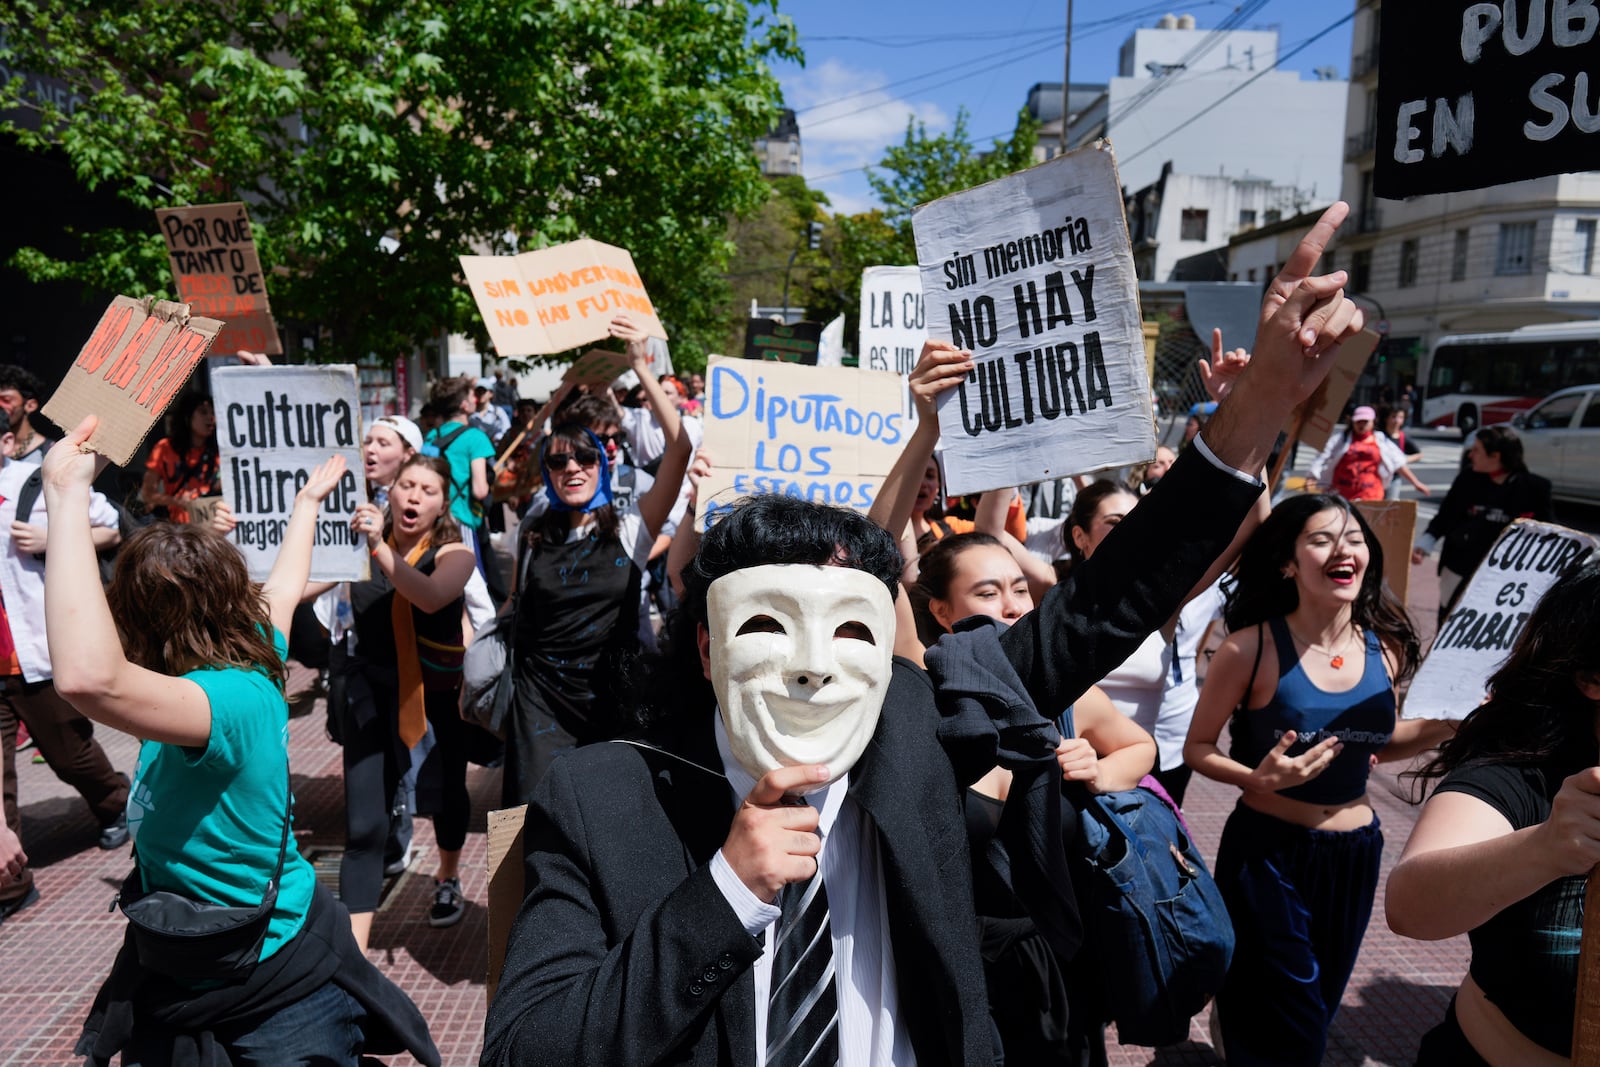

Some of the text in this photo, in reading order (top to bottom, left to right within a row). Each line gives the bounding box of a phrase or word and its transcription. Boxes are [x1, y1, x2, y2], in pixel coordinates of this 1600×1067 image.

[1394, 91, 1475, 164] EN
[163, 208, 252, 247] POR QUÉ
[170, 248, 245, 274] TANTO
[943, 216, 1092, 290] sin memoria
[180, 273, 262, 296] MIEDO DE
[484, 279, 521, 298] SIN
[183, 295, 257, 319] EDUCAR
[494, 308, 530, 328] NO
[536, 303, 570, 328] HAY
[870, 291, 893, 329] LA
[948, 264, 1097, 350] NO HAY
[870, 346, 888, 371] es
[958, 330, 1113, 437] CULTURA
[227, 391, 354, 448] cultura
[755, 441, 831, 476] LOS
[734, 474, 874, 508] ESTAMOS
[235, 515, 359, 551] negacismo
[1495, 582, 1528, 607] es
[1433, 607, 1531, 651] TRABAJ
[1274, 728, 1317, 744] nw
